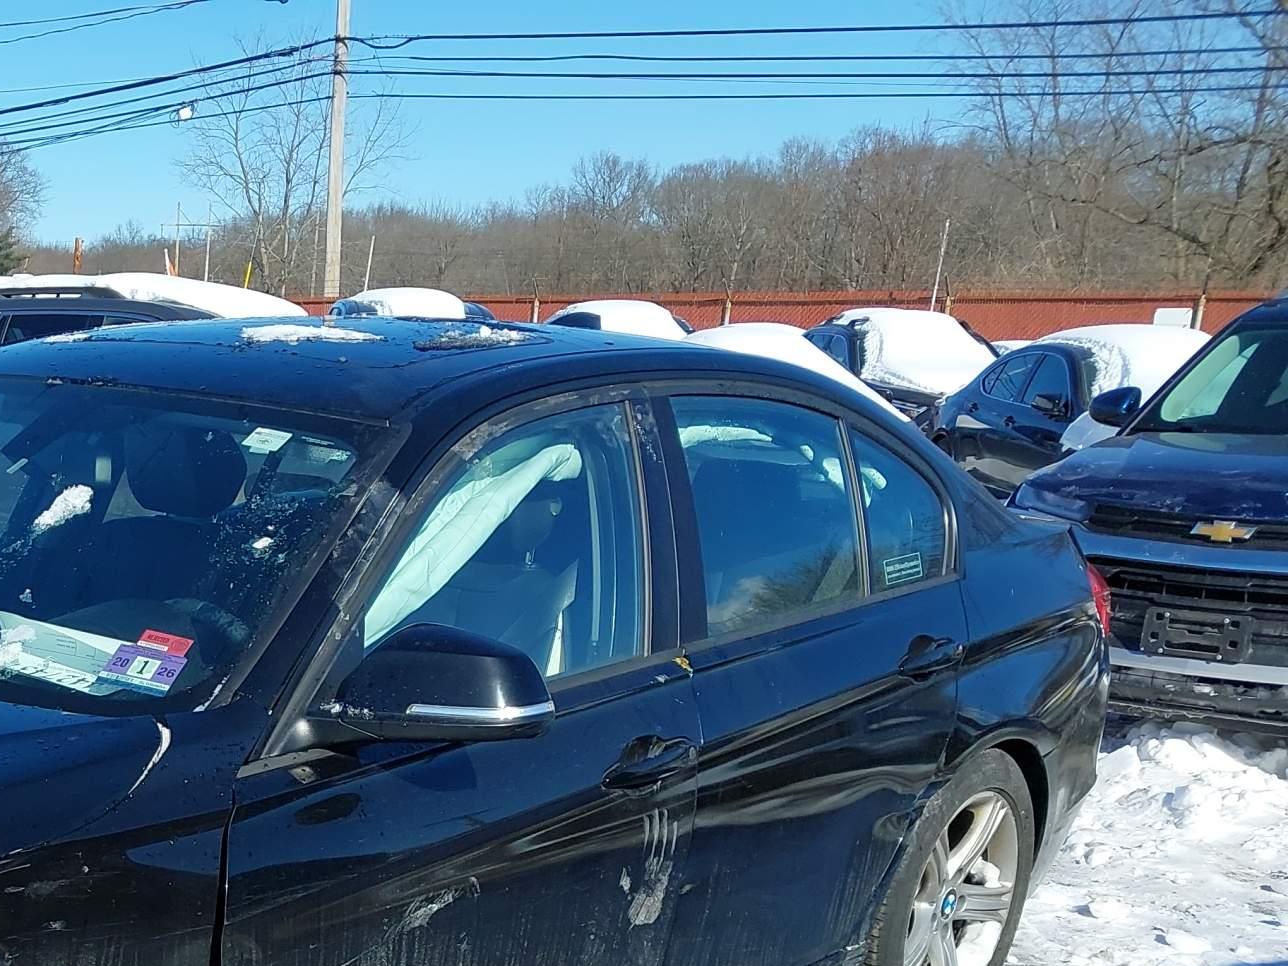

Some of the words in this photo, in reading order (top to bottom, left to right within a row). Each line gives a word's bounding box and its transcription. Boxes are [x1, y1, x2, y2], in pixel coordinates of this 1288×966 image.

[112, 656, 130, 668] 20
[136, 660, 150, 675] 1
[157, 667, 177, 678] 26
